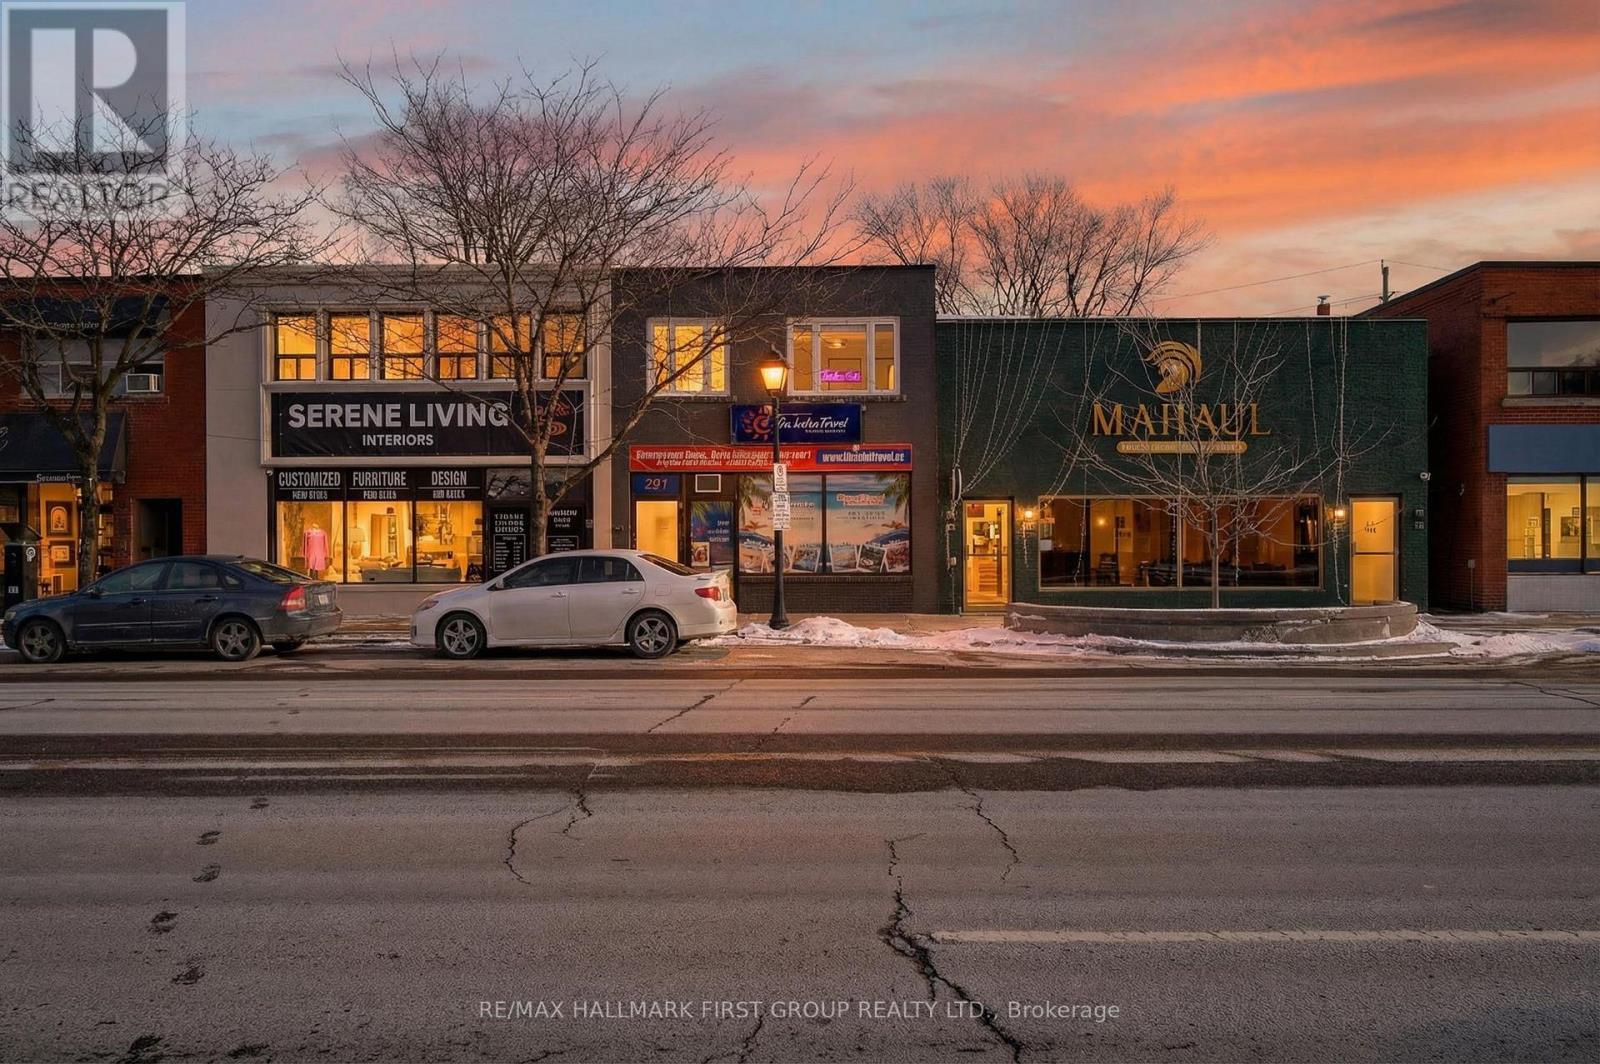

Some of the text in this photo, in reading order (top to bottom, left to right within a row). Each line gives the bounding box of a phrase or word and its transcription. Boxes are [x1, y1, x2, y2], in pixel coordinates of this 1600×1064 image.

[288, 403, 508, 428] SERENE LIVING
[362, 434, 434, 446] INTERIORS
[278, 471, 341, 487] CUSTOMIZED
[431, 470, 467, 486] DESIGN
[645, 478, 668, 490] 291
